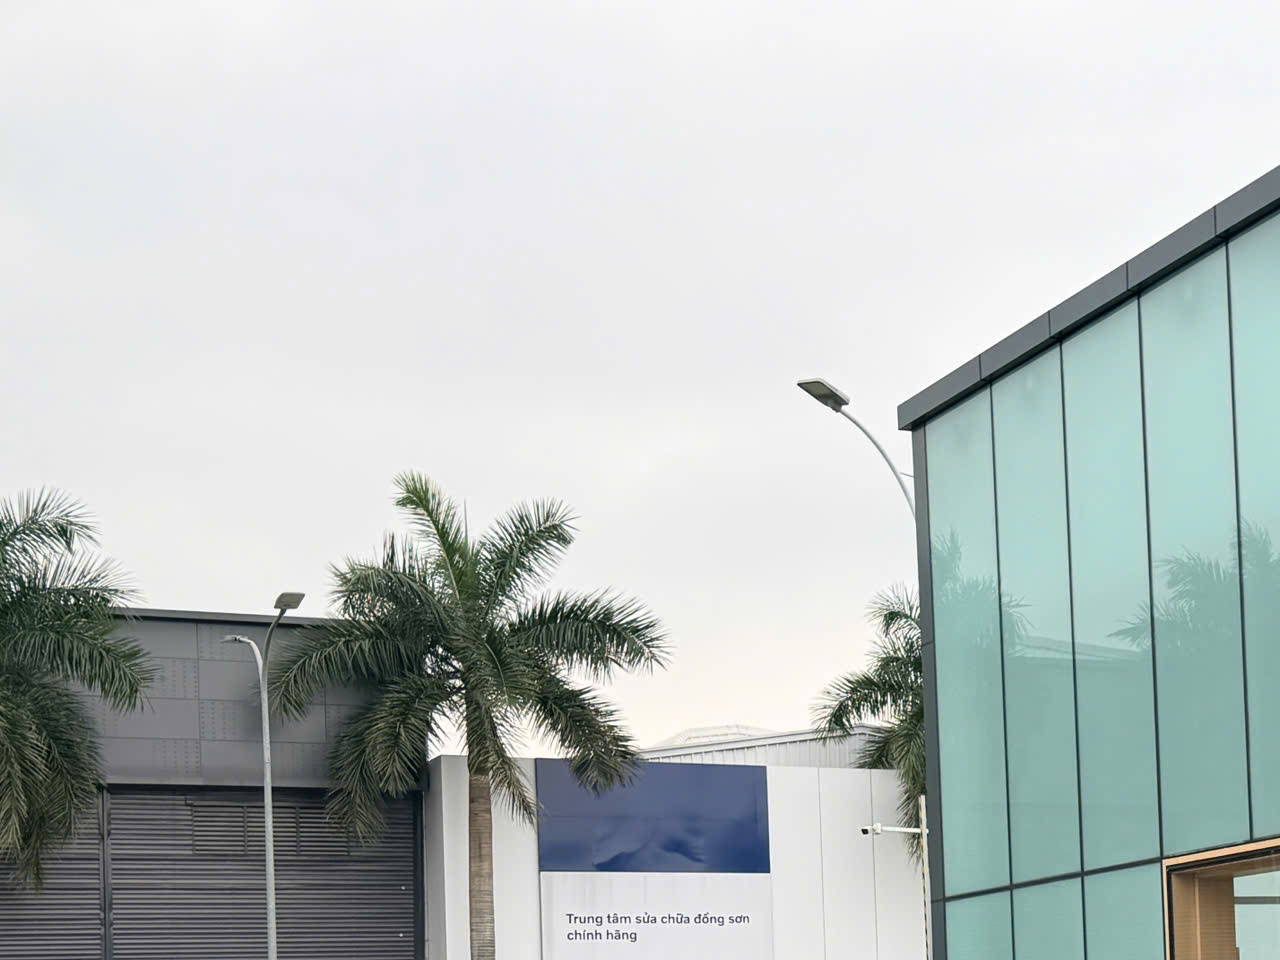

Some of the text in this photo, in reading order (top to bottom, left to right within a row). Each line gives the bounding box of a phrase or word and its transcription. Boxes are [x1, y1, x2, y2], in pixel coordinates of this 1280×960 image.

[566, 911, 750, 927] Trung tâm sửa chữa đồng sơn
[566, 929, 638, 943] chính hãng
